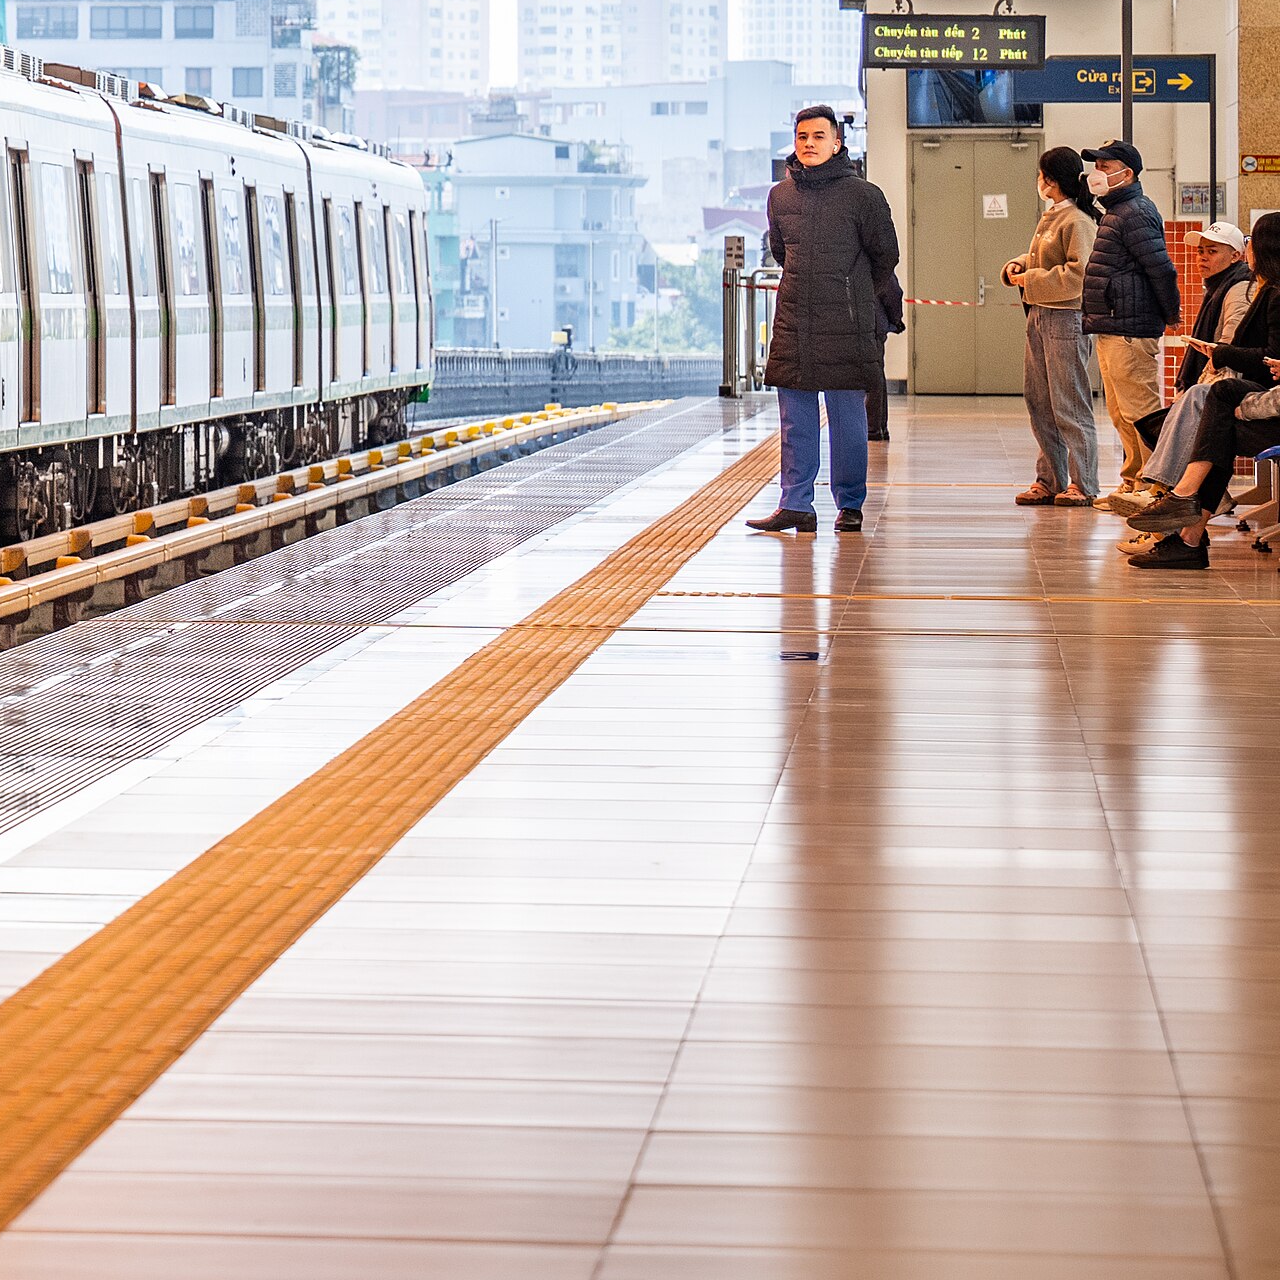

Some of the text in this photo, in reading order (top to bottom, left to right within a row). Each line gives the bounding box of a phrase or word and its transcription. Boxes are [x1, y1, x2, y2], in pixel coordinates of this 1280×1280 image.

[874, 23, 1027, 40] Chuyến tàu đến 2 Phút
[874, 44, 1027, 61] Chuyến tàu tiếp 12 Phút
[1076, 68, 1108, 83] Cửa
